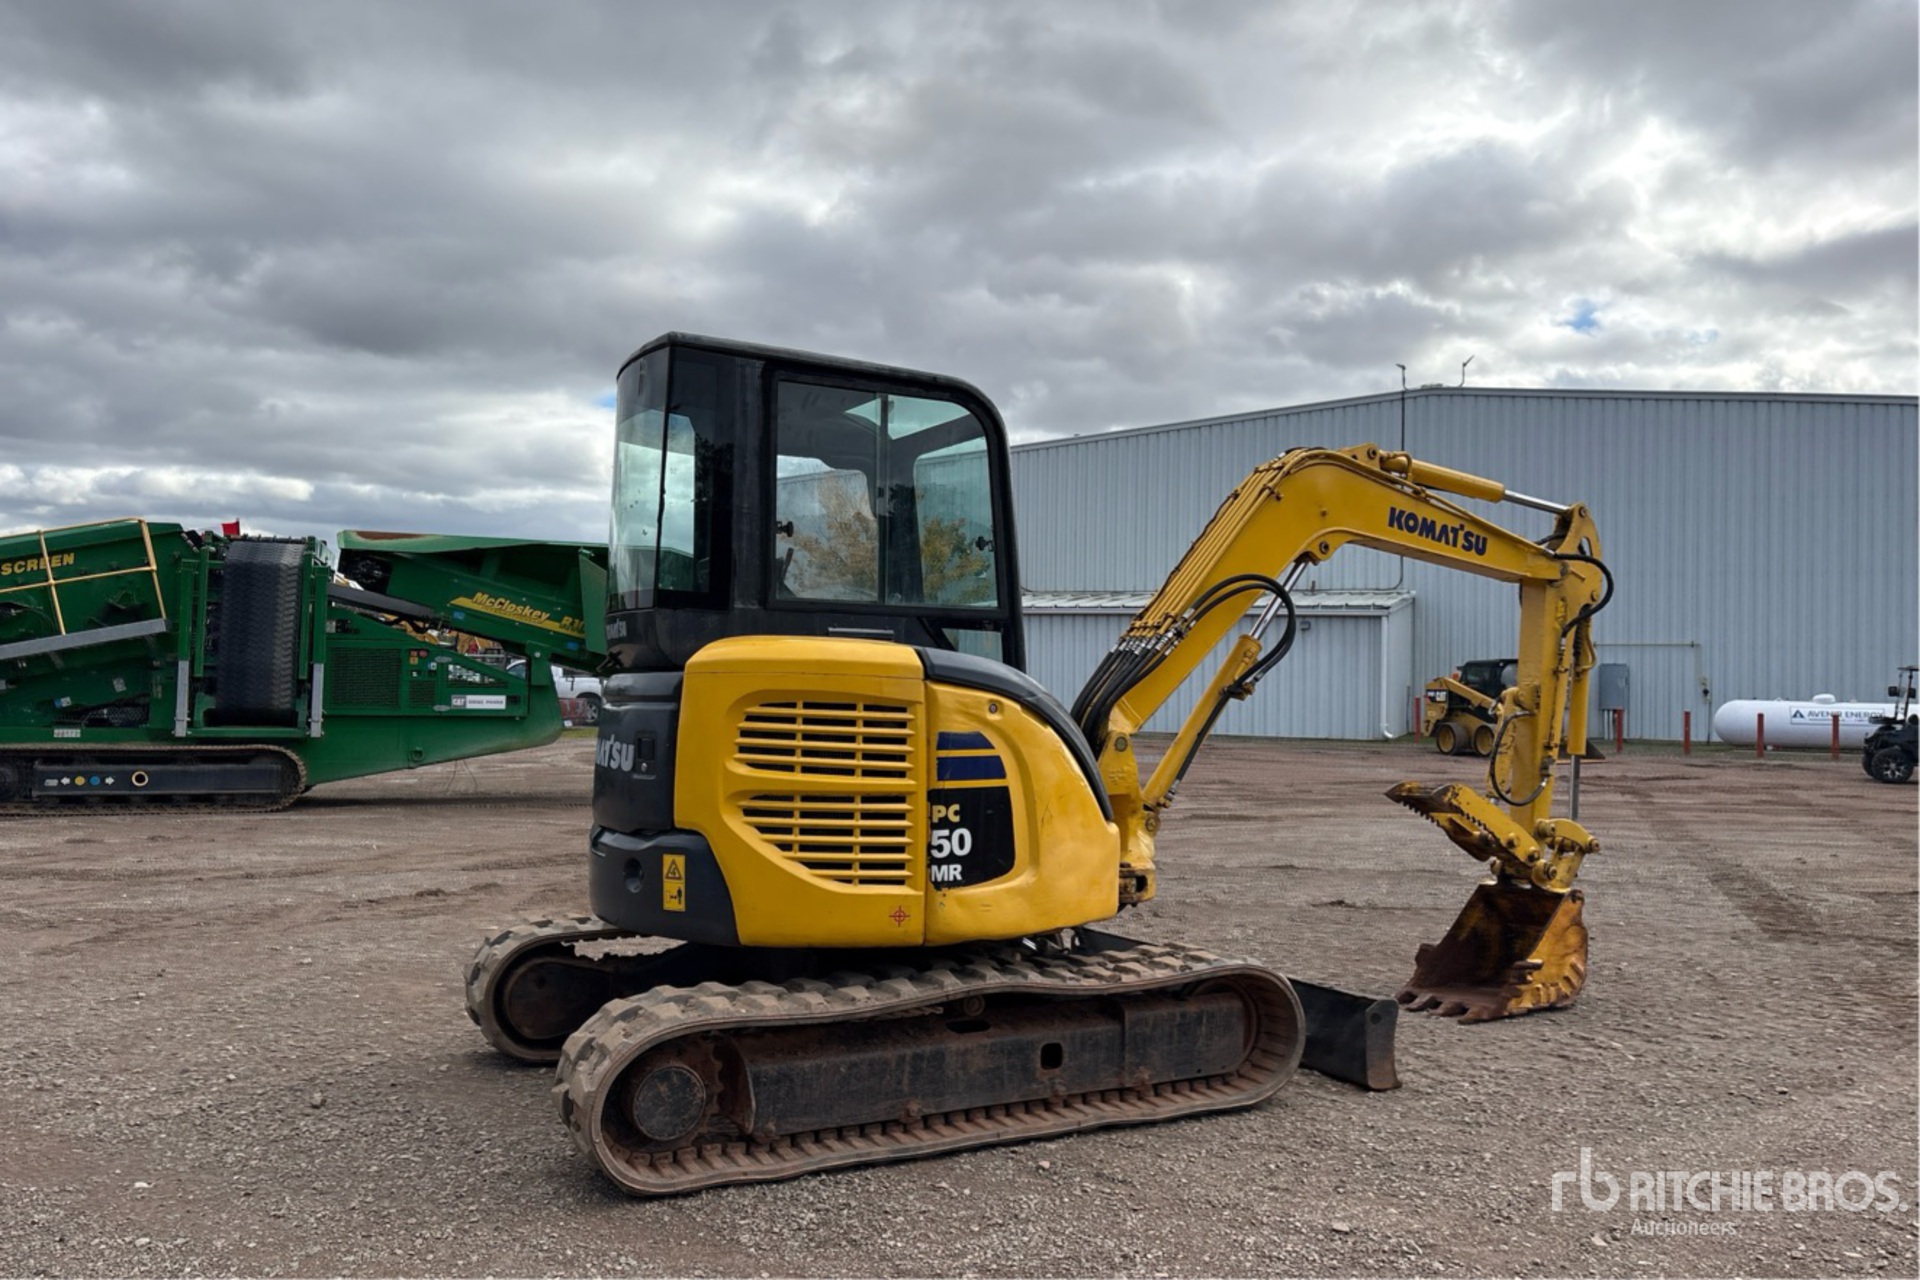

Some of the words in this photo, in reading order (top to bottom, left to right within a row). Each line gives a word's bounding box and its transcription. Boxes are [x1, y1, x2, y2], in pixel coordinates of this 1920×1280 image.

[1388, 506, 1488, 556] KOMATSU
[0, 552, 75, 576] SCREEN
[472, 592, 550, 624] McCloskey
[1807, 710, 1842, 719] AVENR
[932, 804, 961, 823] PC
[930, 828, 972, 859] 50
[931, 864, 962, 882] MR
